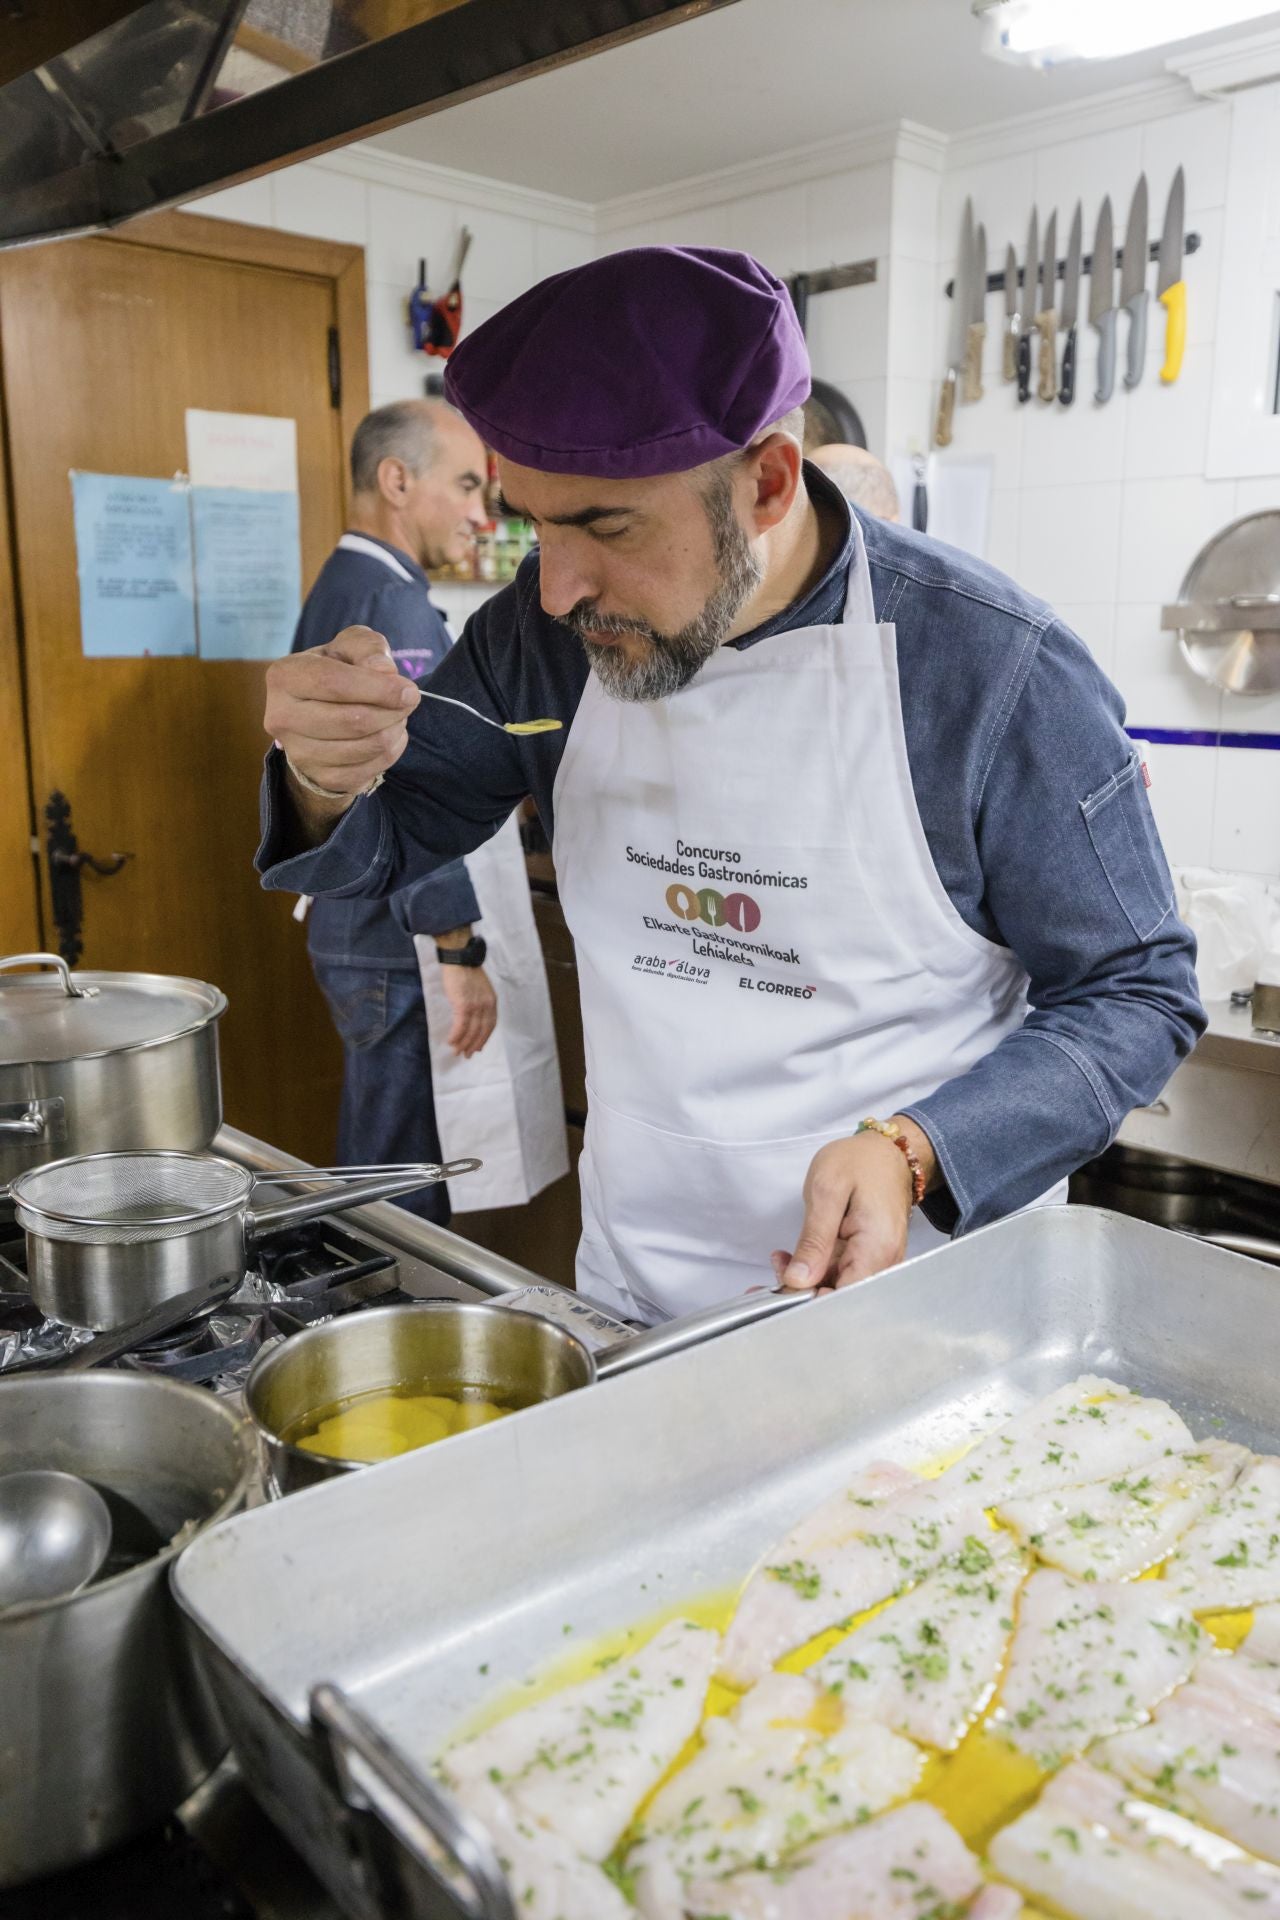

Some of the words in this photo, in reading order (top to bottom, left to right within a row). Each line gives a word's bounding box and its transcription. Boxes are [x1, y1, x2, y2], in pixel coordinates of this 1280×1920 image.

[677, 839, 741, 863] Concurso
[626, 846, 695, 877] Sociedades
[698, 861, 808, 889] Gastronómicas
[643, 916, 691, 935] Elkarte
[692, 926, 801, 965] Gastronomikoak
[692, 939, 755, 967] Lehiaketa
[634, 955, 667, 969] araba
[676, 961, 711, 979] álava
[738, 977, 754, 990] EL
[756, 980, 813, 1000] CORREO
